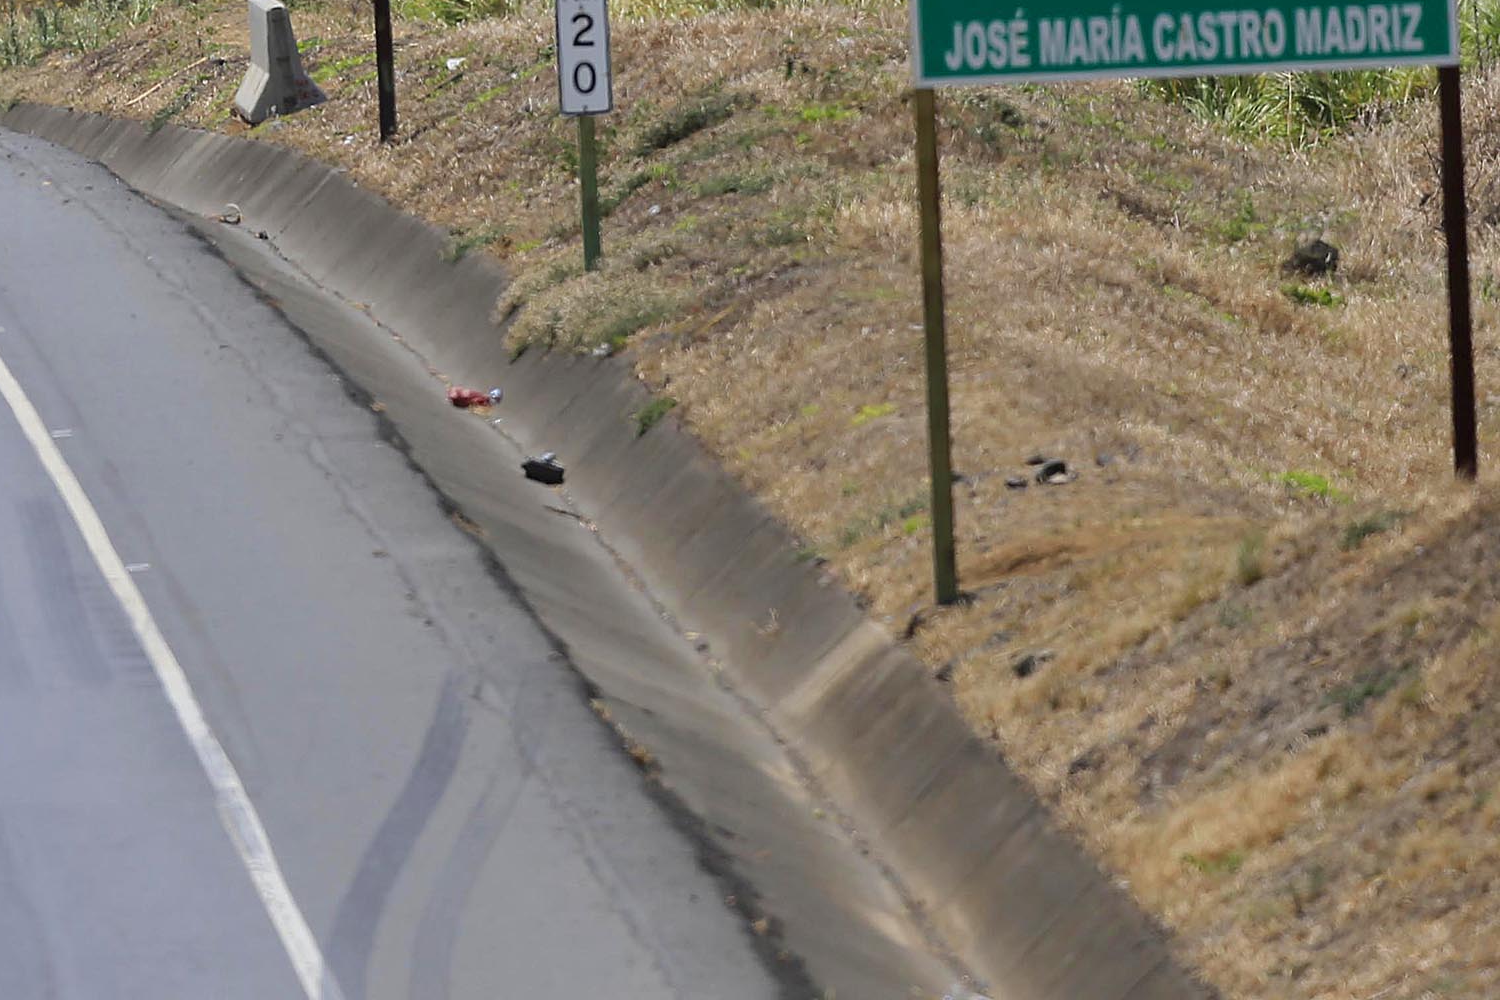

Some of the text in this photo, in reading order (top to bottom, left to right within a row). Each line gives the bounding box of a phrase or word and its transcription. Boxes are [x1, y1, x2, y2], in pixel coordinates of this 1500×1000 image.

[945, 3, 1424, 71] JOSÉ MARÍA CASTRO MADRIZ
